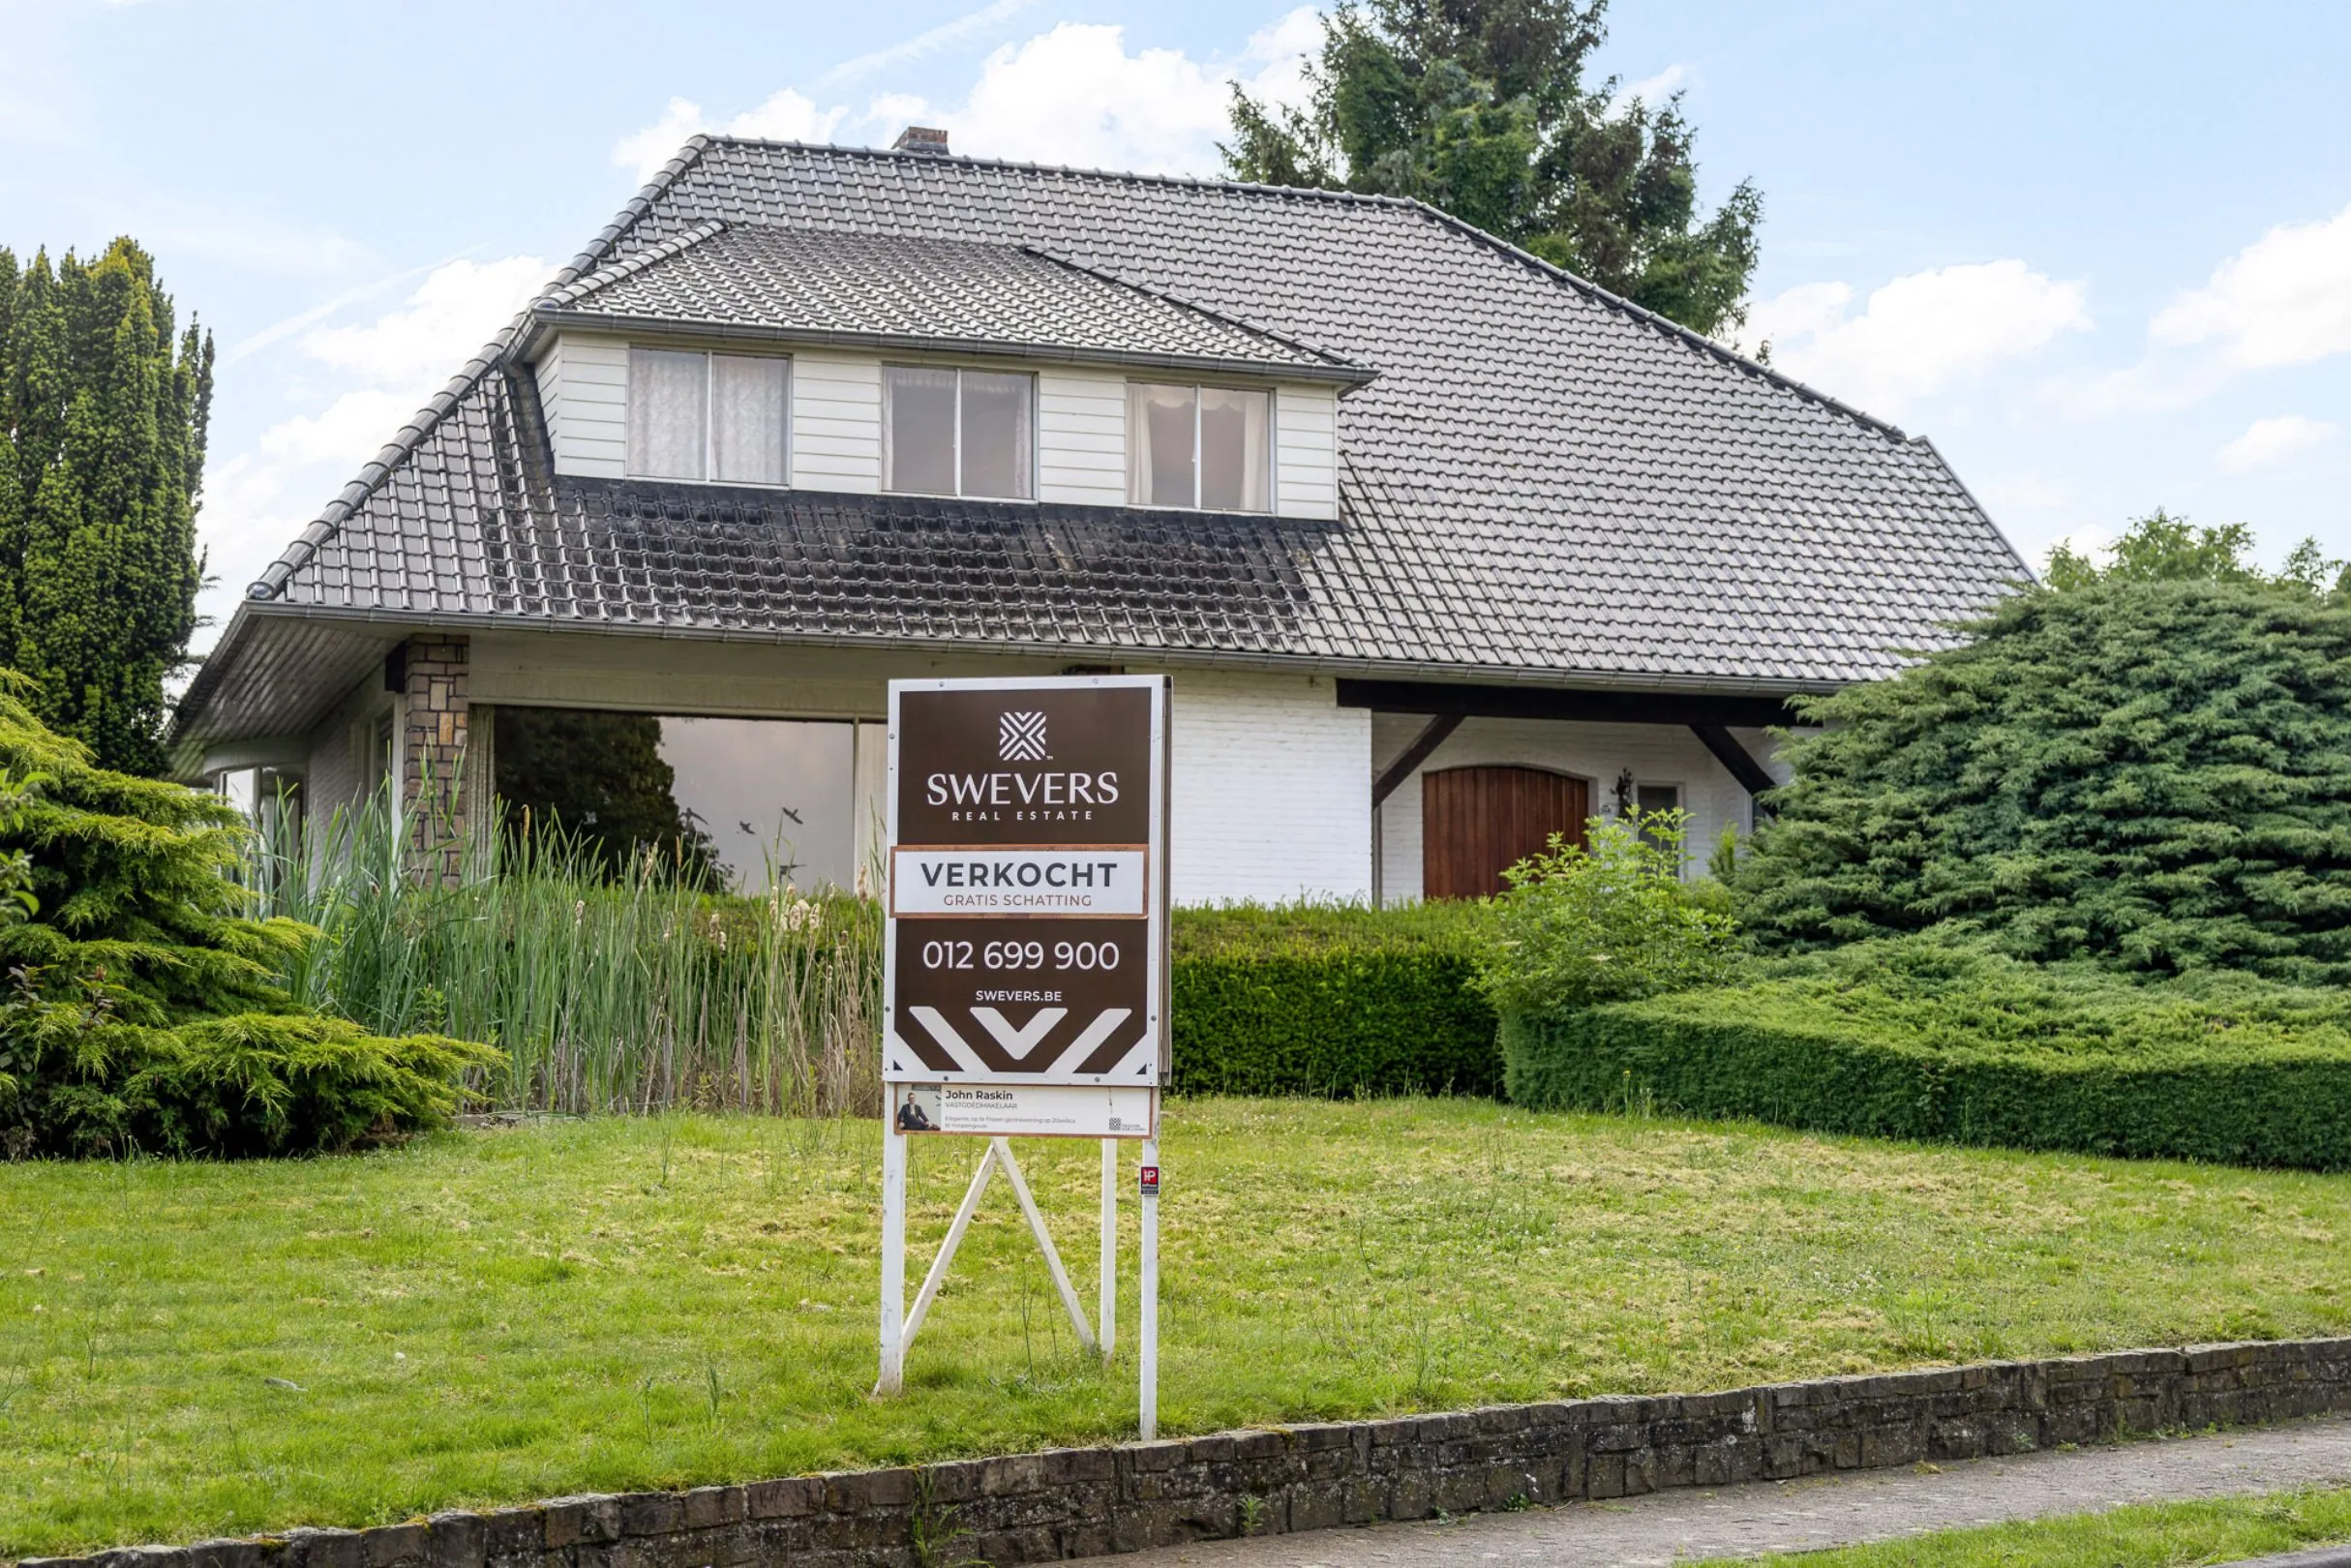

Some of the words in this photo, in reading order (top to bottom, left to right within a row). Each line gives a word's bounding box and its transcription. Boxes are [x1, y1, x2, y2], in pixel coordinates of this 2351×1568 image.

[926, 771, 1119, 806] SWEVERS
[952, 811, 1000, 822] REAL
[1016, 810, 1092, 821] ESTATE
[920, 861, 1118, 888] VERKOCHT
[944, 894, 998, 906] GRATIS
[1003, 894, 1092, 907] SCHATTING
[922, 941, 975, 969] 012
[983, 941, 1044, 970] 699
[1054, 941, 1120, 971] 900
[976, 990, 1062, 1002] SWEVERS.BE
[945, 1090, 973, 1100] John
[976, 1090, 1013, 1101] Raskin
